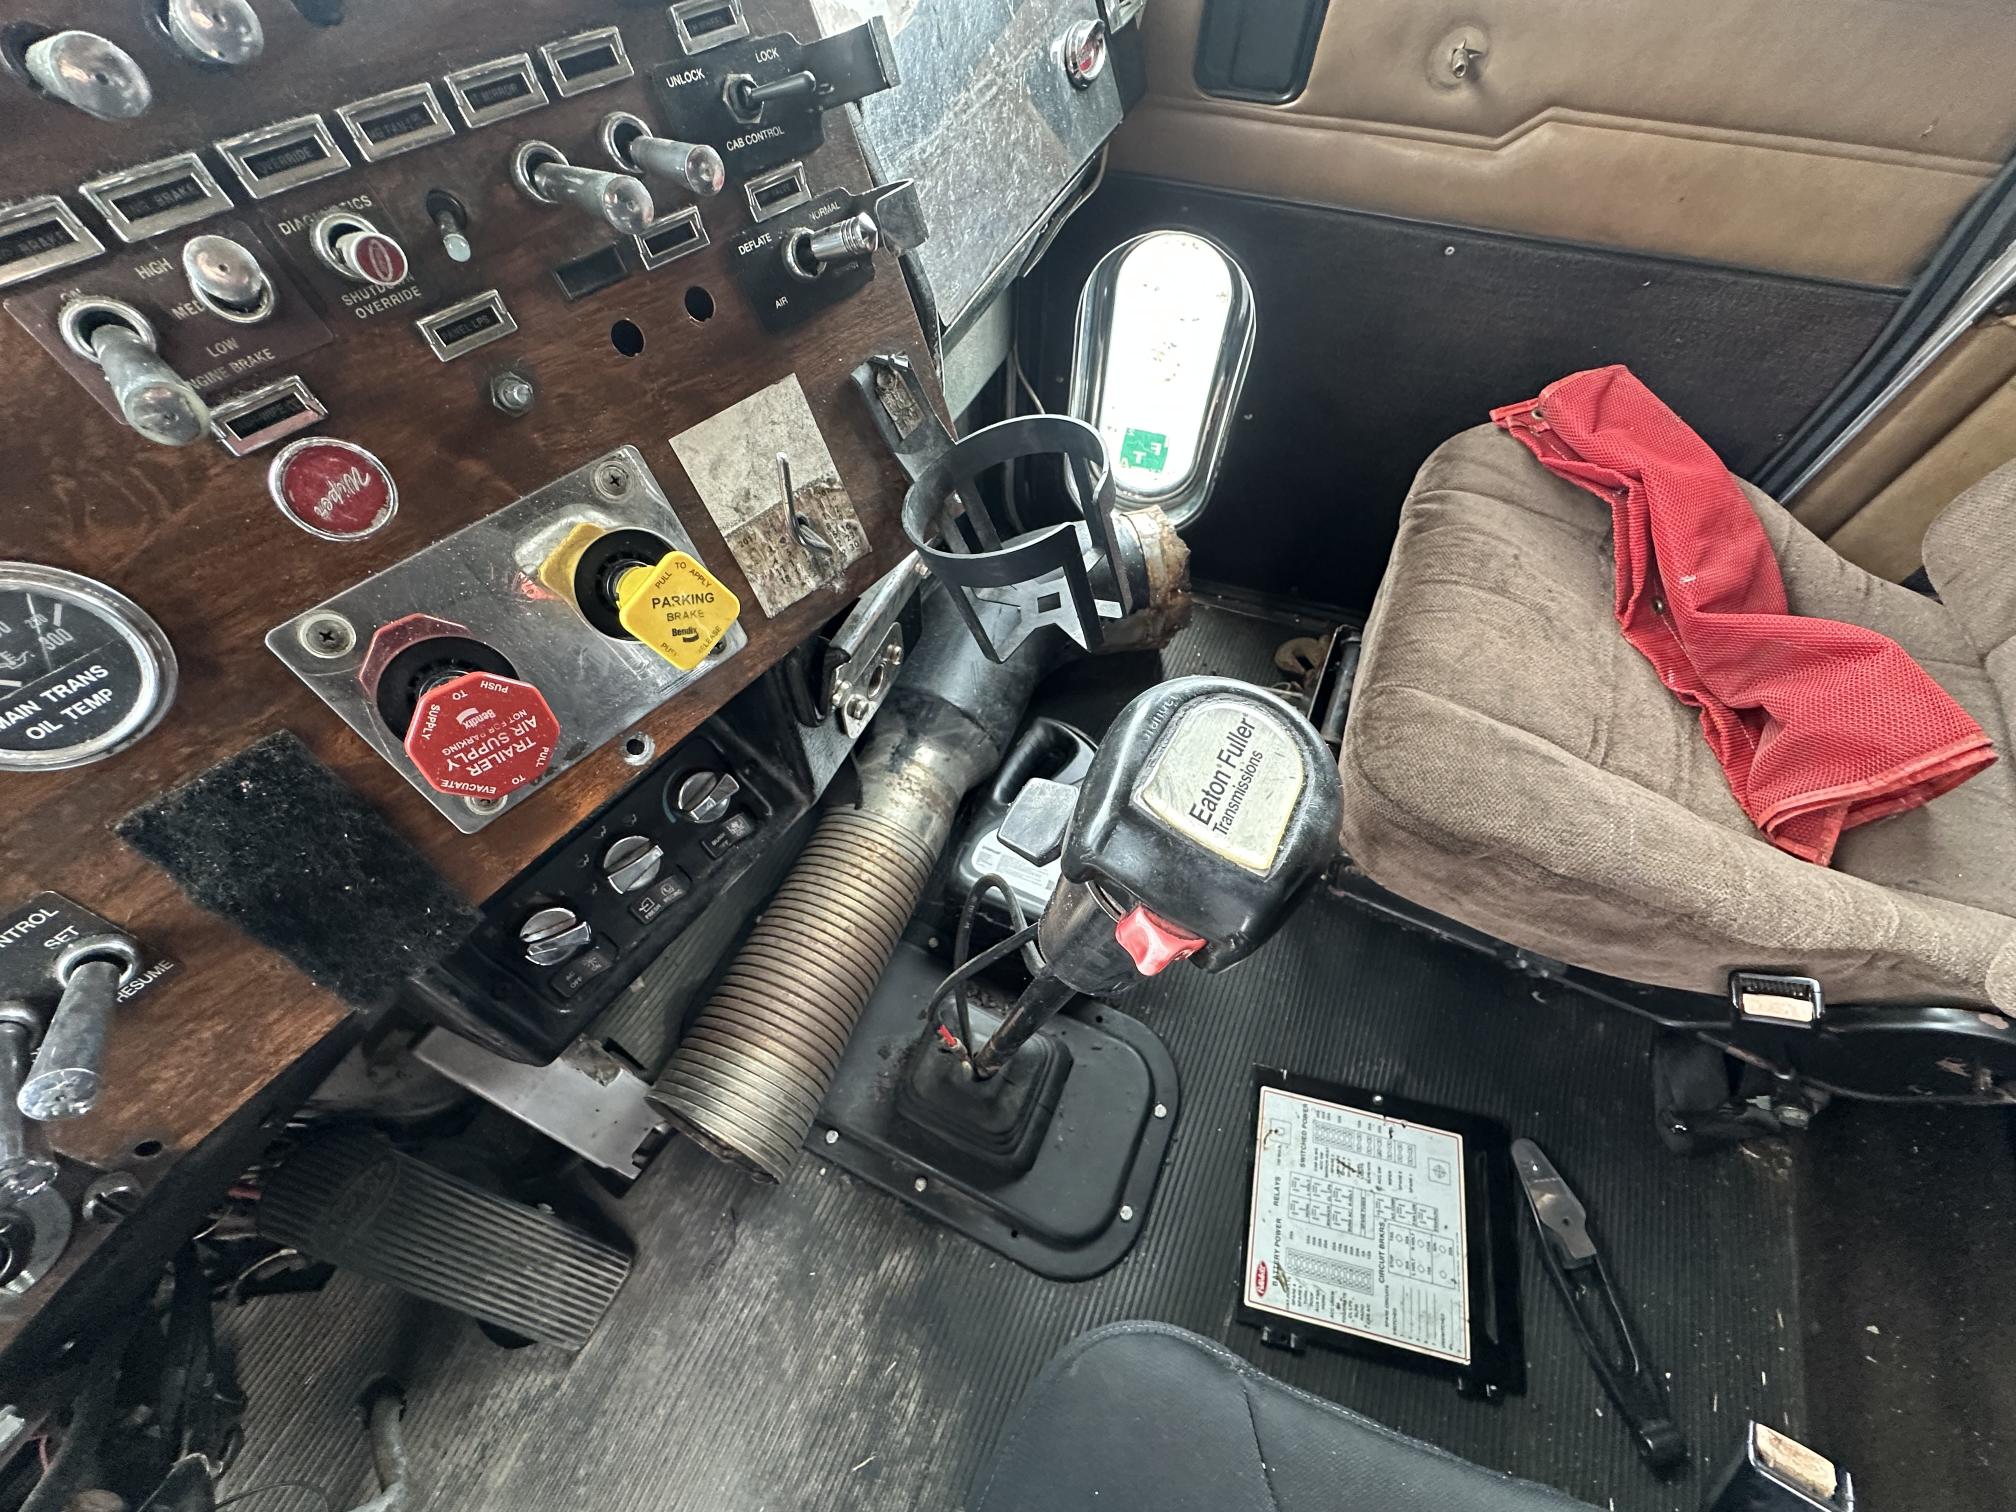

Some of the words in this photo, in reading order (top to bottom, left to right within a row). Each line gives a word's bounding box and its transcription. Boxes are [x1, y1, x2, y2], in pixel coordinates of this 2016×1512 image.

[755, 48, 779, 63] LOCK
[666, 68, 706, 88] UNLOCK
[726, 135, 745, 151] CAB
[745, 125, 784, 145] CONTROL
[808, 201, 841, 221] NORMAL
[738, 233, 773, 256] DEFLATE
[134, 257, 174, 280] HIGH
[171, 300, 206, 321] MED
[355, 286, 421, 319] OVERRIDE
[775, 296, 789, 309] AIR
[205, 336, 240, 358] LOW
[229, 348, 276, 373] BRAKE
[313, 466, 371, 520] Wiper
[655, 571, 673, 589] PULL
[675, 561, 686, 569] TO
[689, 568, 712, 588] APPLY
[652, 592, 715, 609] PARKING
[667, 609, 705, 622] BRAKE
[38, 628, 74, 651] 300
[672, 626, 697, 637] Bendix
[0, 699, 43, 732] MAIN
[40, 664, 109, 703] TRANS
[452, 689, 468, 701] TO
[480, 680, 509, 694] PUSH
[25, 719, 65, 741] OIL
[60, 687, 114, 720] TEMP
[421, 704, 441, 741] SUPPLY
[462, 708, 497, 730] Bendix
[509, 709, 528, 724] NOT
[510, 715, 537, 736] AIR
[442, 733, 486, 757] PARKING
[446, 732, 511, 772] SUPPLY
[466, 736, 537, 777] TRAILER
[536, 746, 550, 768] PULL
[511, 774, 526, 785] TO
[1188, 769, 1232, 826] Eaton
[1216, 716, 1256, 769] Fuller
[440, 778, 497, 795] EVACUATE
[1212, 749, 1264, 836] Transmissions
[43, 925, 80, 949] SET
[1301, 1103, 1309, 1130] POWER
[1272, 1176, 1281, 1206] RELAYS
[1274, 1218, 1282, 1248] POWER
[1377, 1251, 1385, 1284] CIRCUIT
